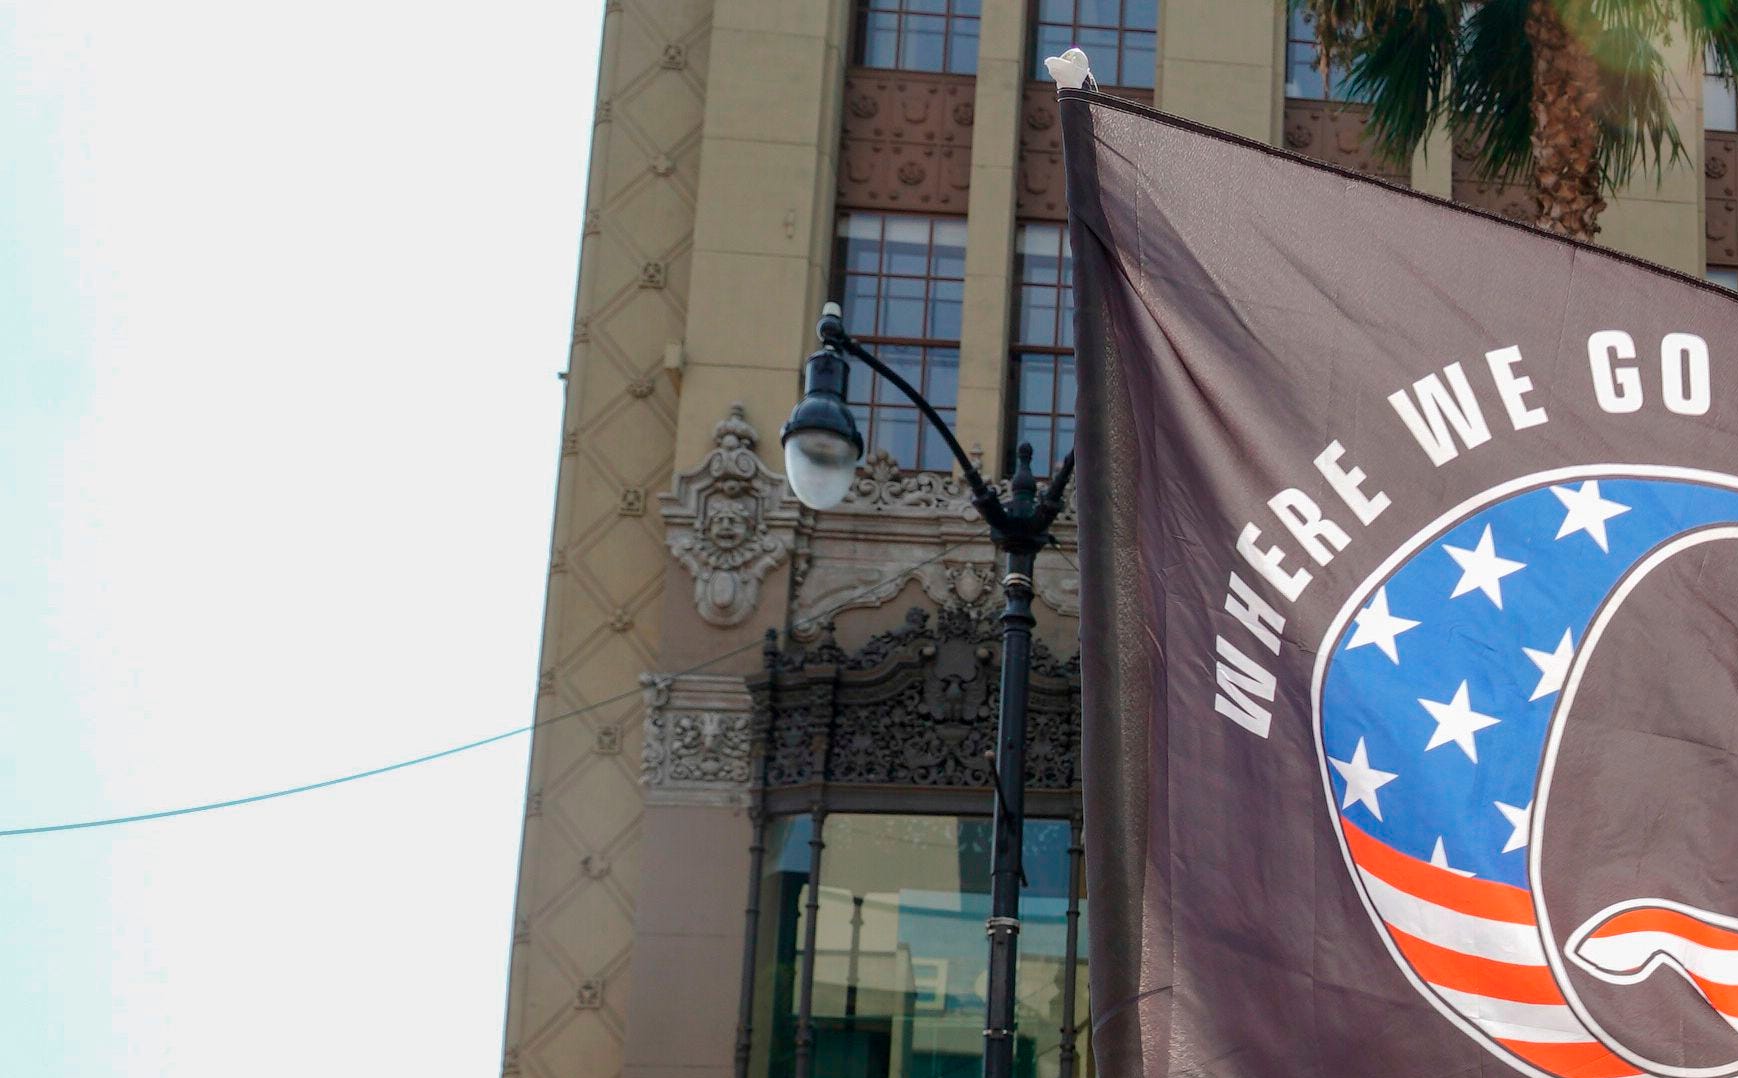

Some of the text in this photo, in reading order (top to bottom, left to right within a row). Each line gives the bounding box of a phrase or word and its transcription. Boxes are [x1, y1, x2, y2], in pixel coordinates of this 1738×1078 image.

[1214, 439, 1392, 739] WHERE
[1387, 345, 1549, 467] WE
[1588, 330, 1711, 415] GO
